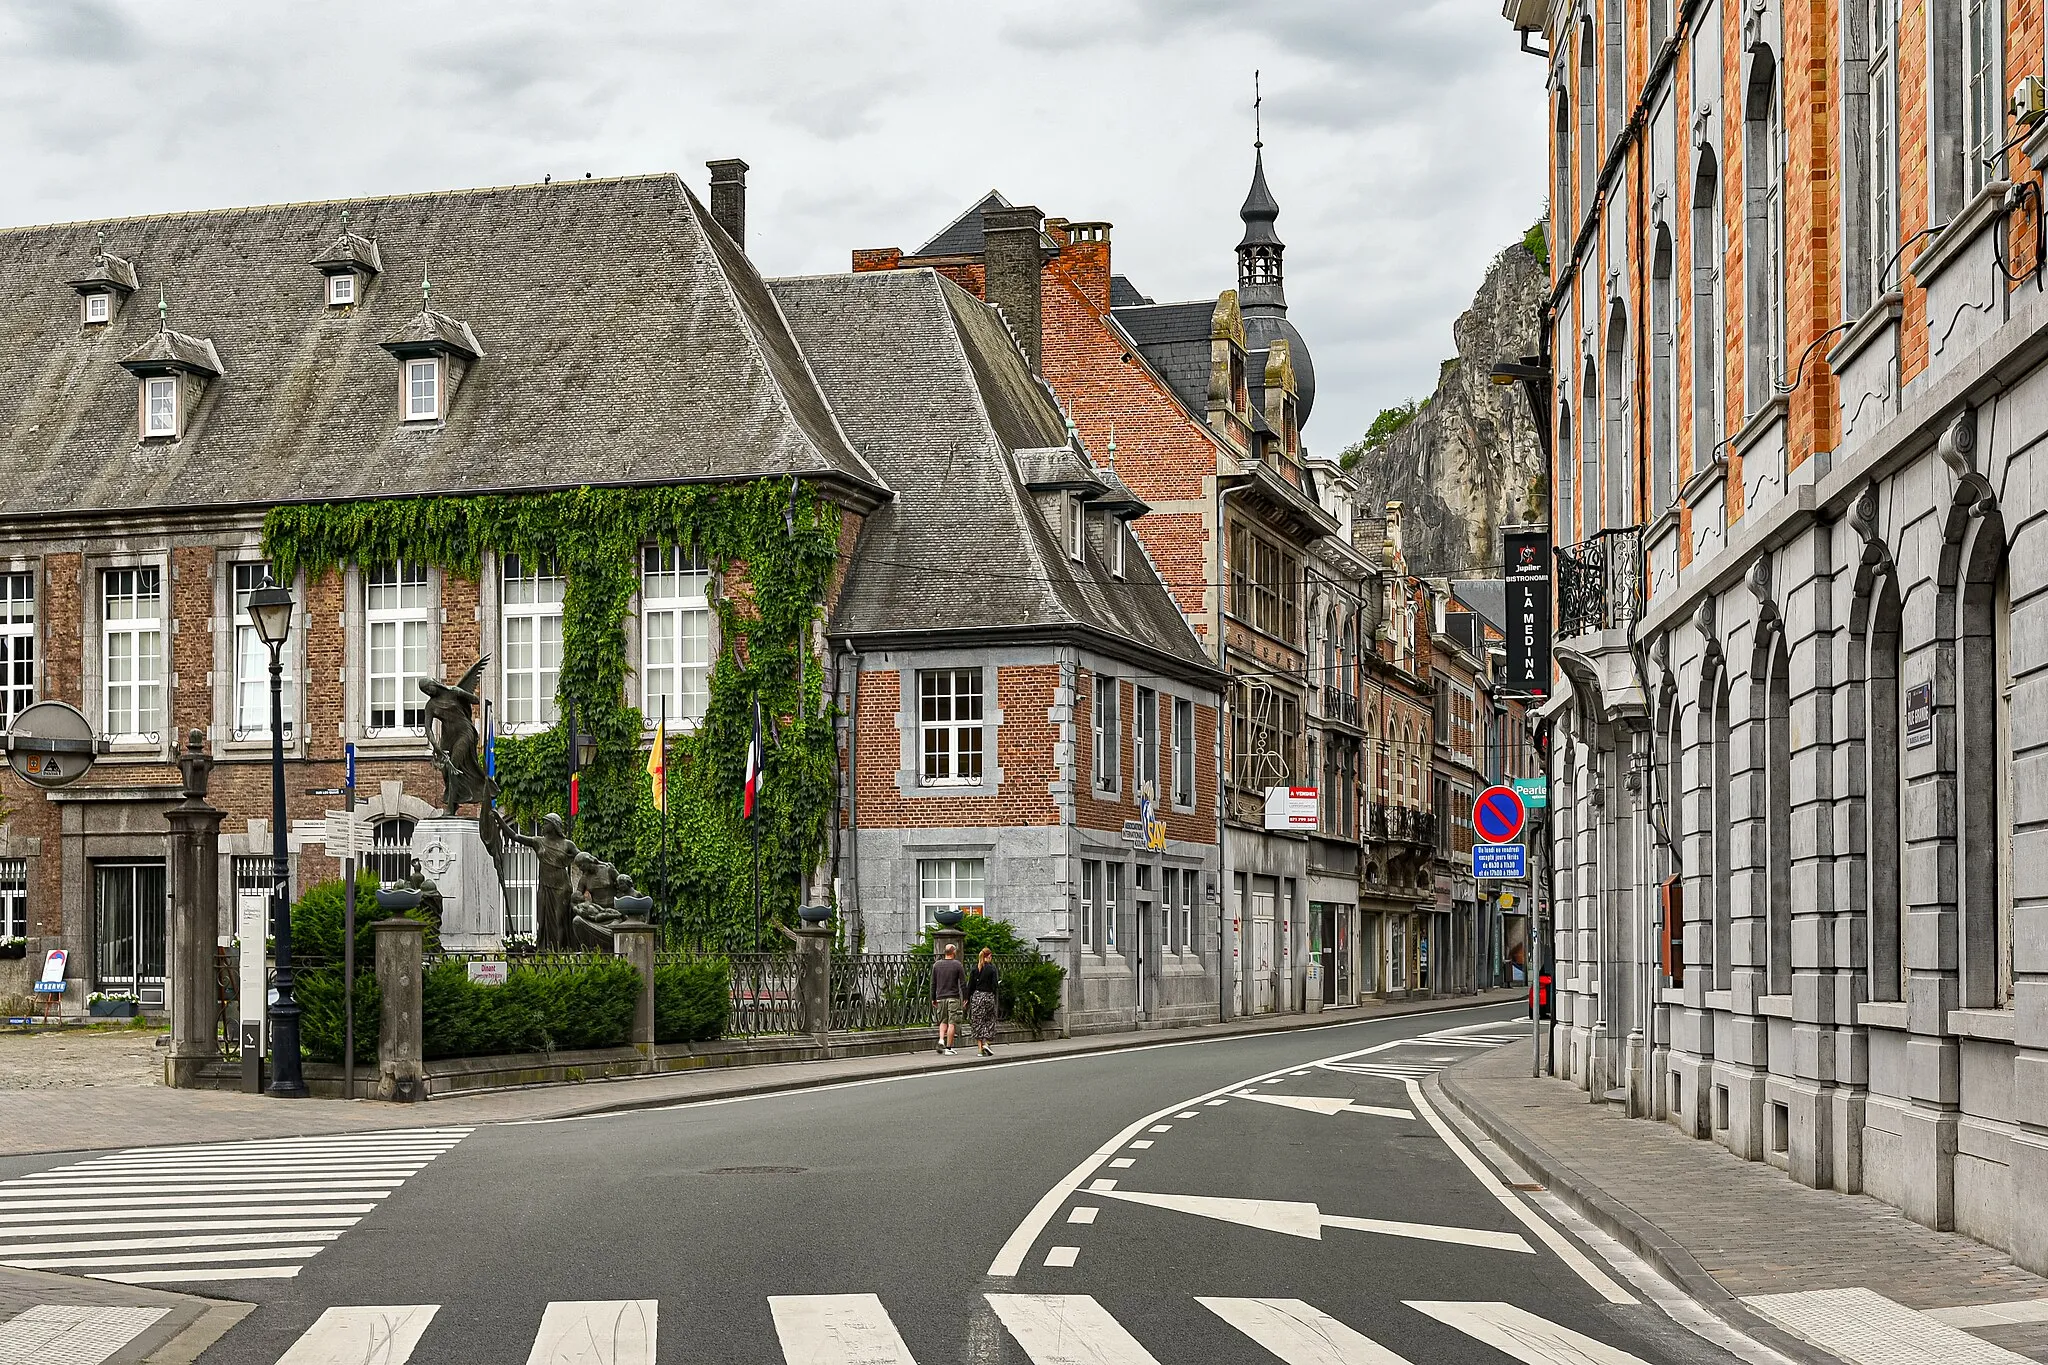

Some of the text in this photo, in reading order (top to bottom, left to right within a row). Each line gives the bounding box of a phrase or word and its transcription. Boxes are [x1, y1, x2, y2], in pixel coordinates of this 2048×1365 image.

[1515, 564, 1541, 572] Jupiler
[1523, 586, 1534, 608] LA
[1523, 613, 1535, 680] MEDINA
[1516, 785, 1547, 795] Pearle
[1124, 822, 1143, 831] ASSOCIATION
[1148, 821, 1167, 851] SAX
[481, 964, 496, 972] Dinant
